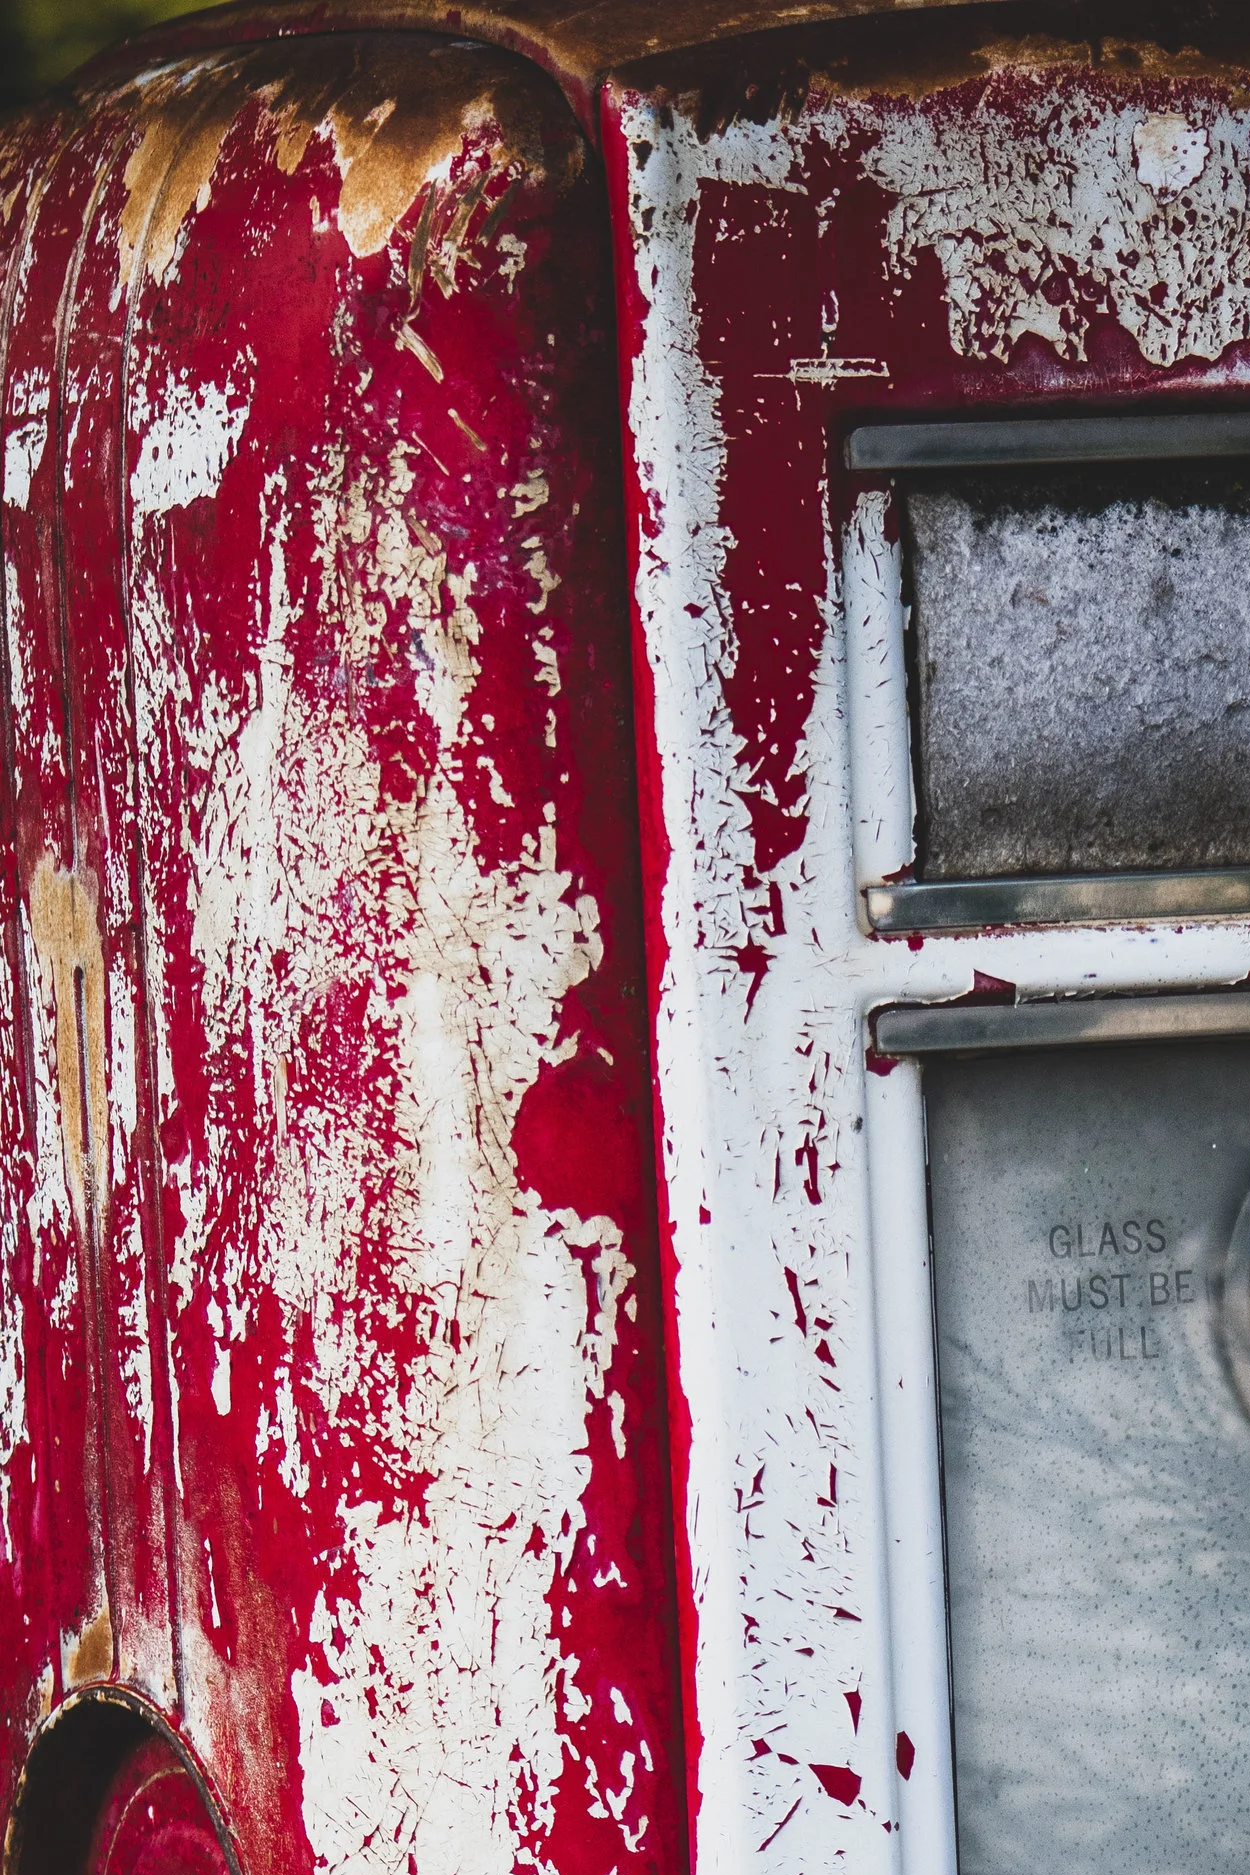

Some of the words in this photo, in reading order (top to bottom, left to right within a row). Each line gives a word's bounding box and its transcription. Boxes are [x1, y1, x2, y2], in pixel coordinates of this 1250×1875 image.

[1049, 1218, 1167, 1260] GLASS
[1026, 1273, 1131, 1314] MUST
[1149, 1269, 1195, 1306] BE
